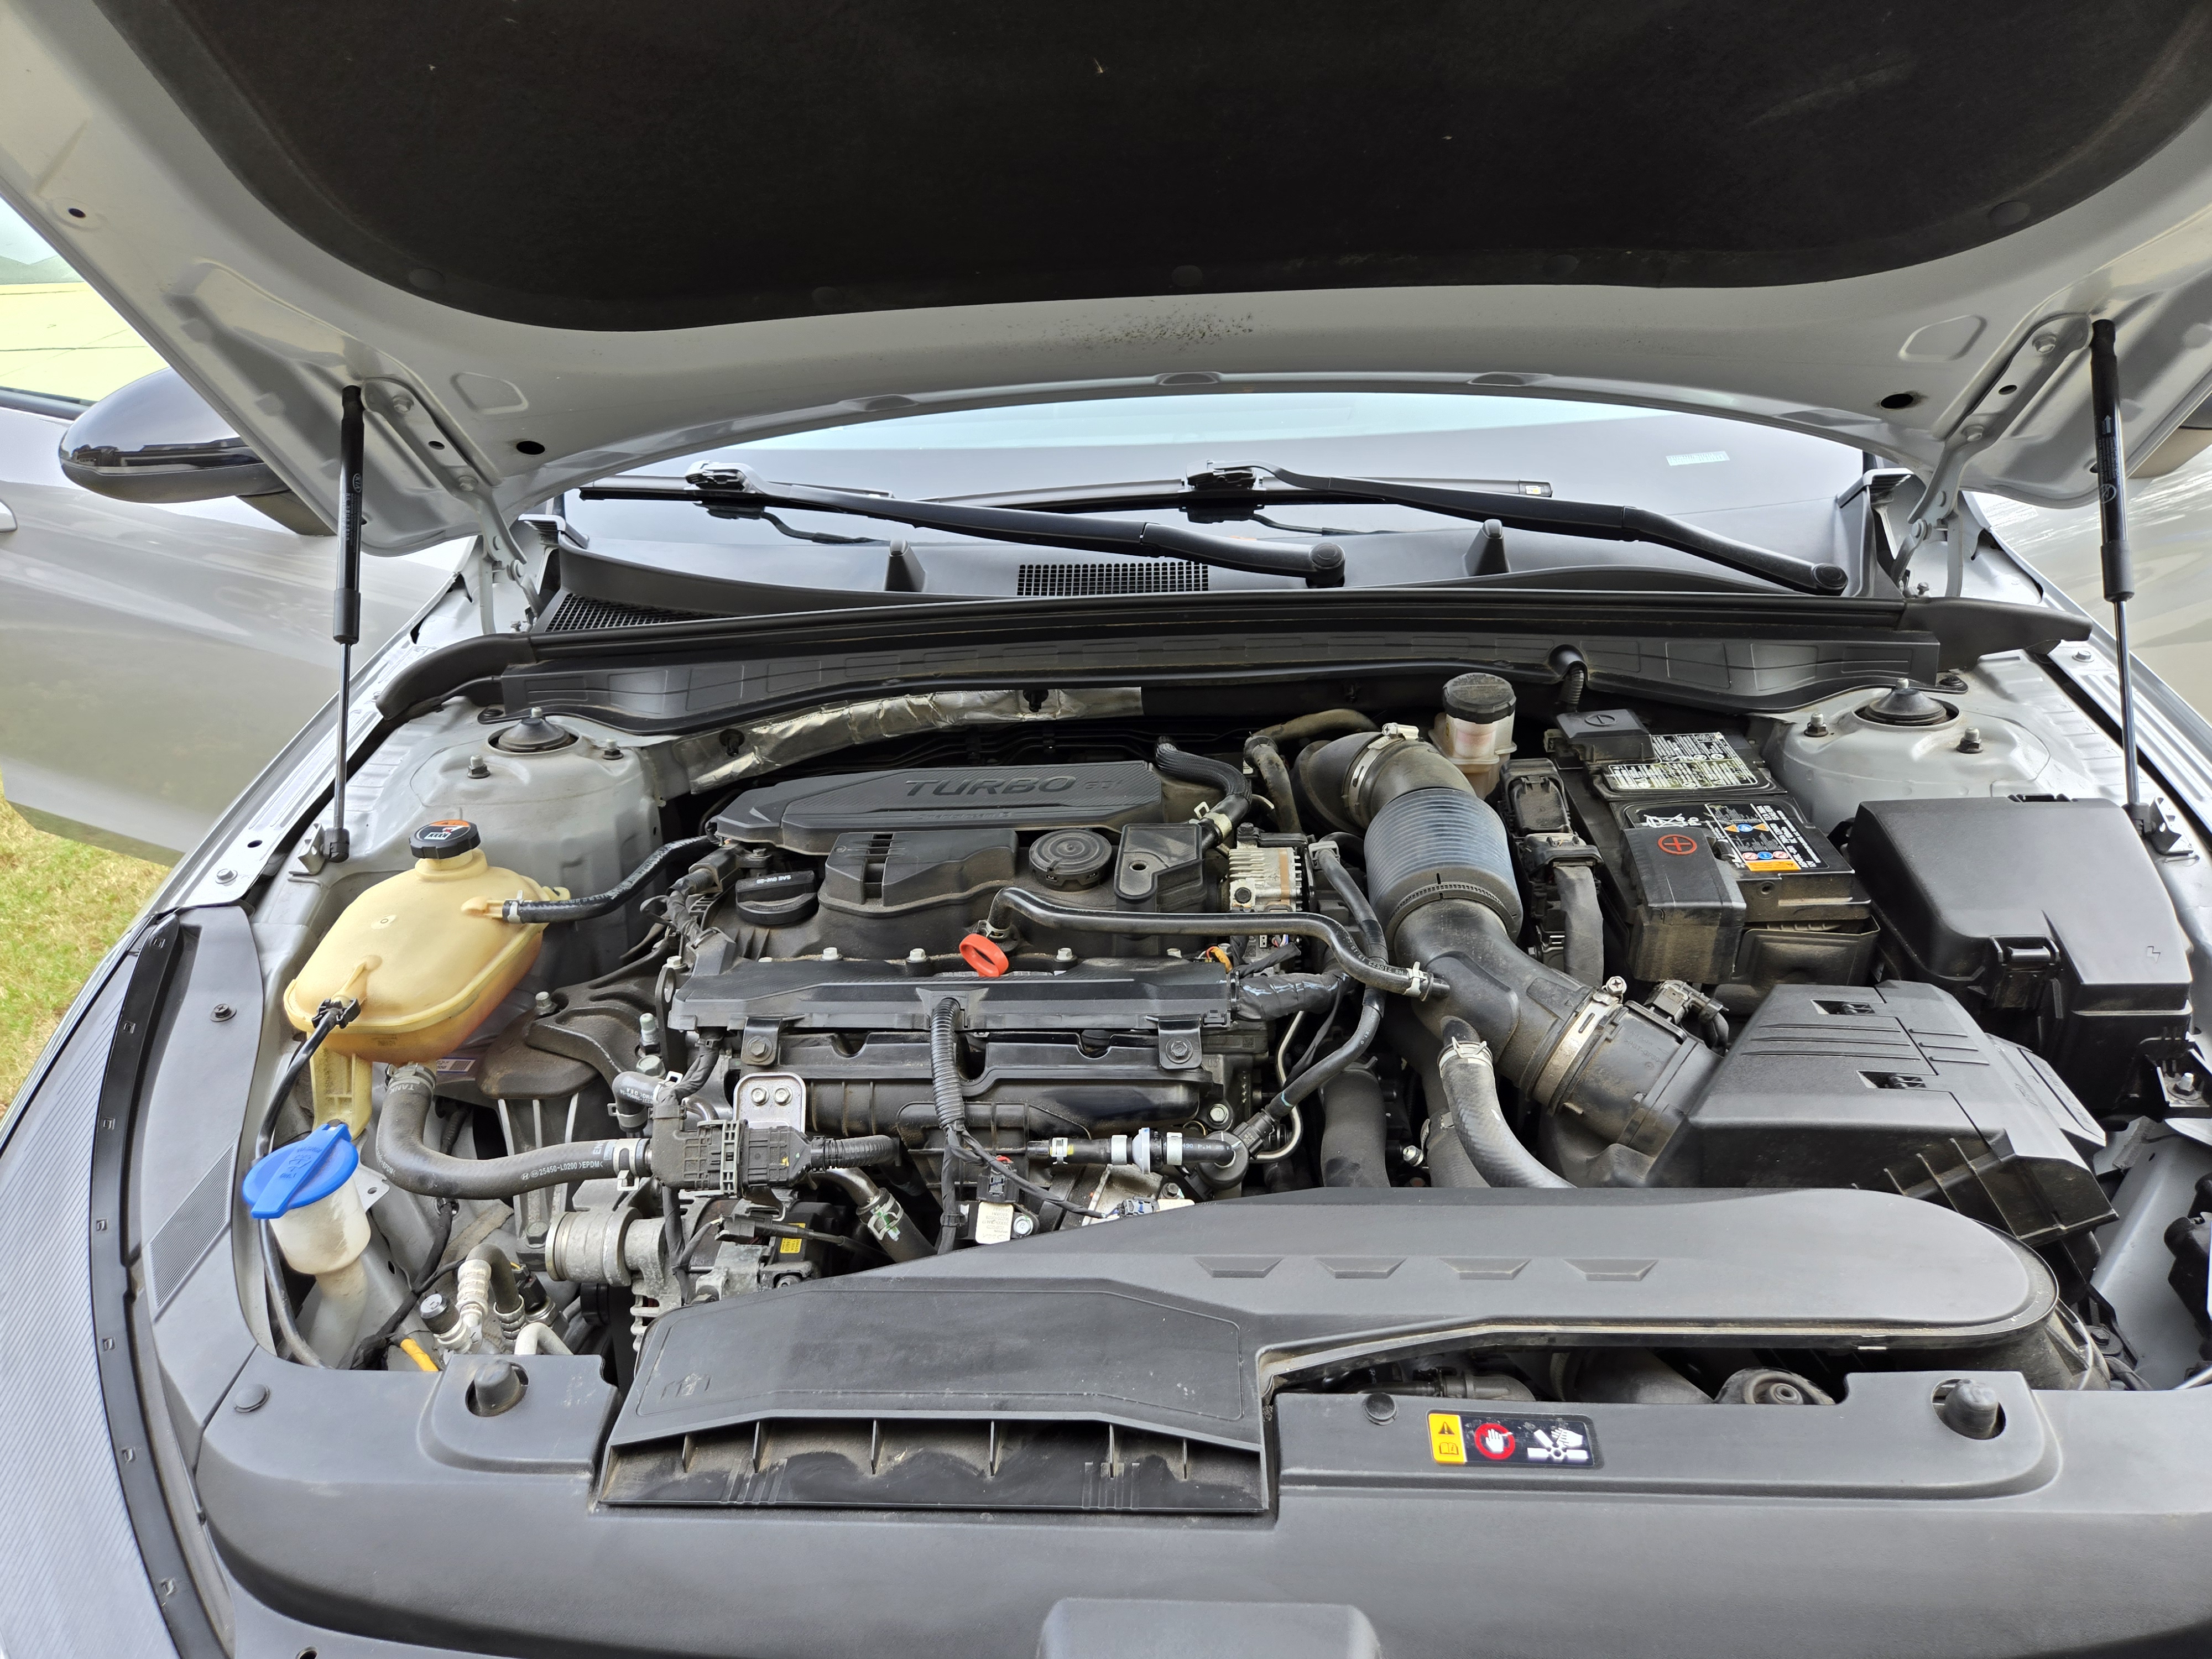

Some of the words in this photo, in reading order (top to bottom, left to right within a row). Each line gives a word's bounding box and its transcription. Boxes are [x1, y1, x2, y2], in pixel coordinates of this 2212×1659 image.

[353, 475, 362, 491] KIA
[905, 775, 1077, 796] TURBO
[389, 1084, 414, 1094] TANK
[539, 1162, 578, 1177] 25450-L0200
[578, 1160, 604, 1170] >EPDM<
